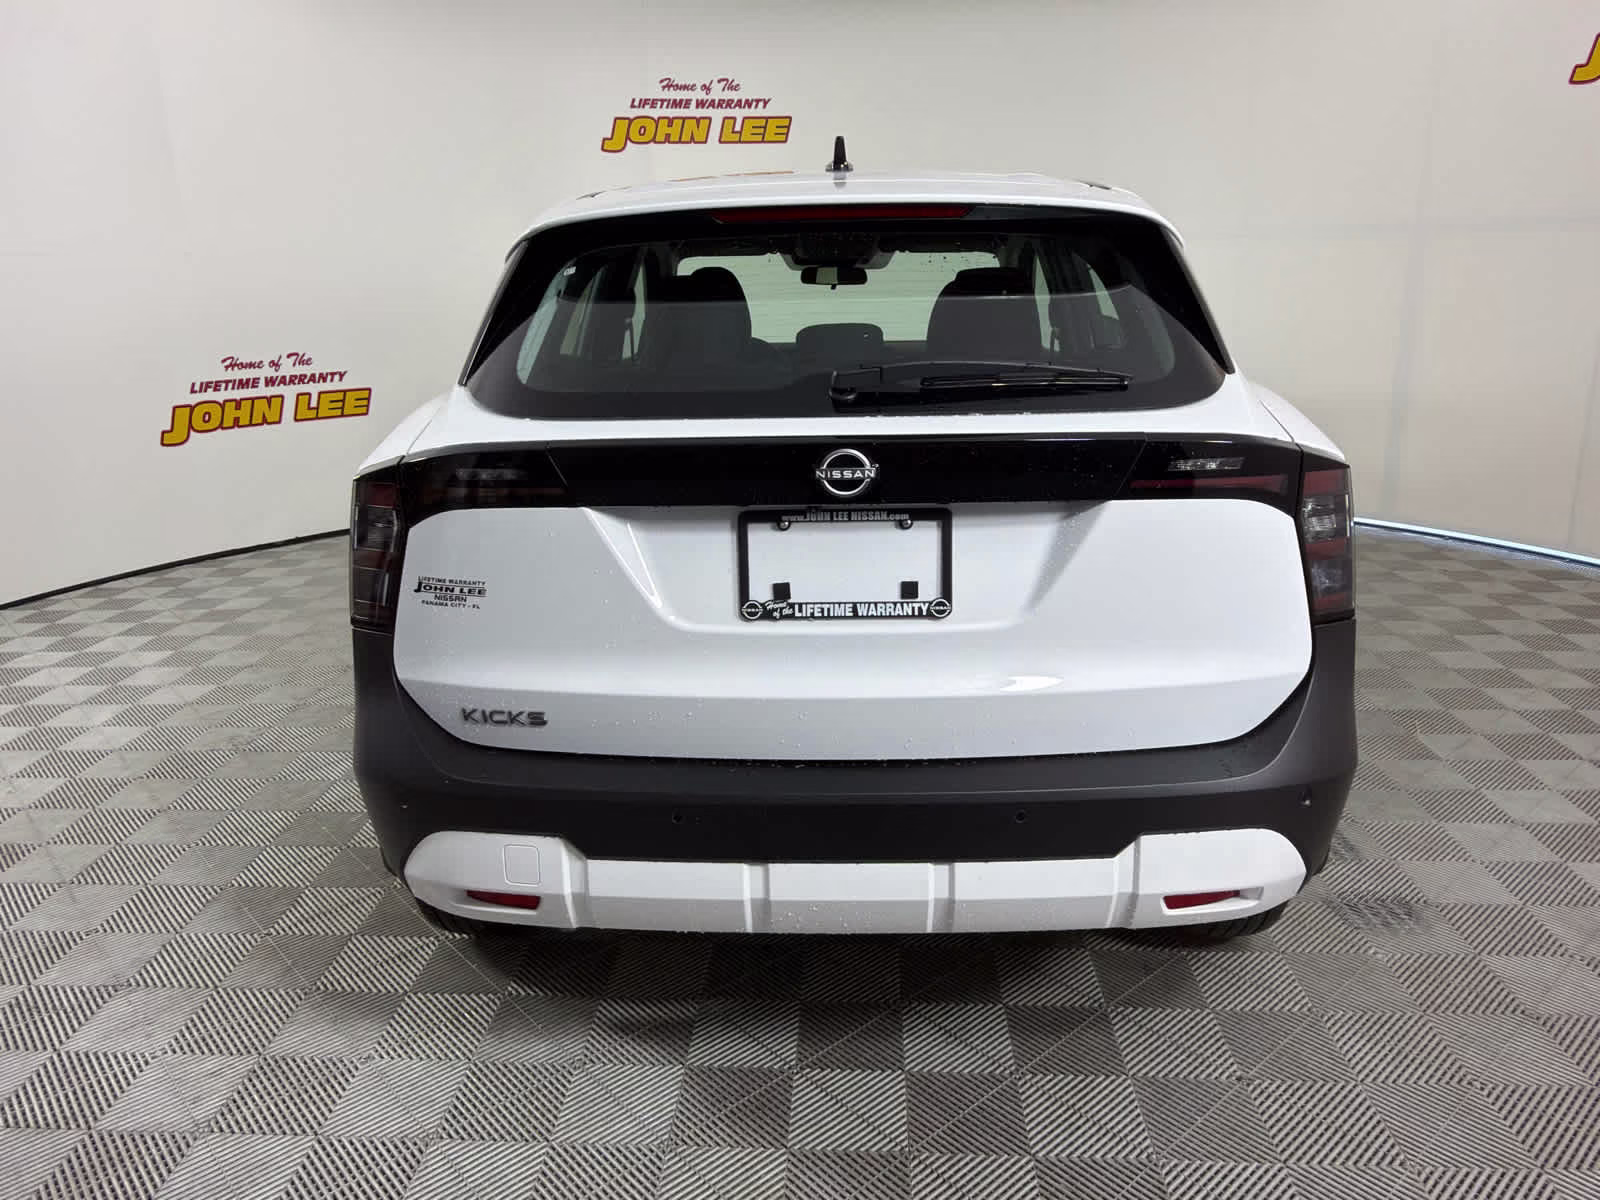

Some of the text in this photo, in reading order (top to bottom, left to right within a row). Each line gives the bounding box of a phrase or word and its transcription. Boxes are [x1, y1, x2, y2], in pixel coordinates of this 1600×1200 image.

[659, 78, 741, 94] Home of The
[630, 98, 772, 109] LIFETIME WARRANTY
[601, 115, 792, 153] JOHN LEE
[221, 352, 312, 372] Home of The
[190, 371, 347, 394] LIFETIME WARRANTY
[161, 388, 372, 446] JOHN LEE
[816, 470, 875, 479] NISSAN
[833, 512, 849, 521] LEE
[418, 576, 446, 584] LIFETIME
[414, 582, 487, 596] JOHN LEE
[434, 594, 467, 602] NISSAN
[764, 600, 787, 610] Home
[795, 603, 930, 617] LIFETIME WARRANTY
[462, 708, 548, 727] KICKS
